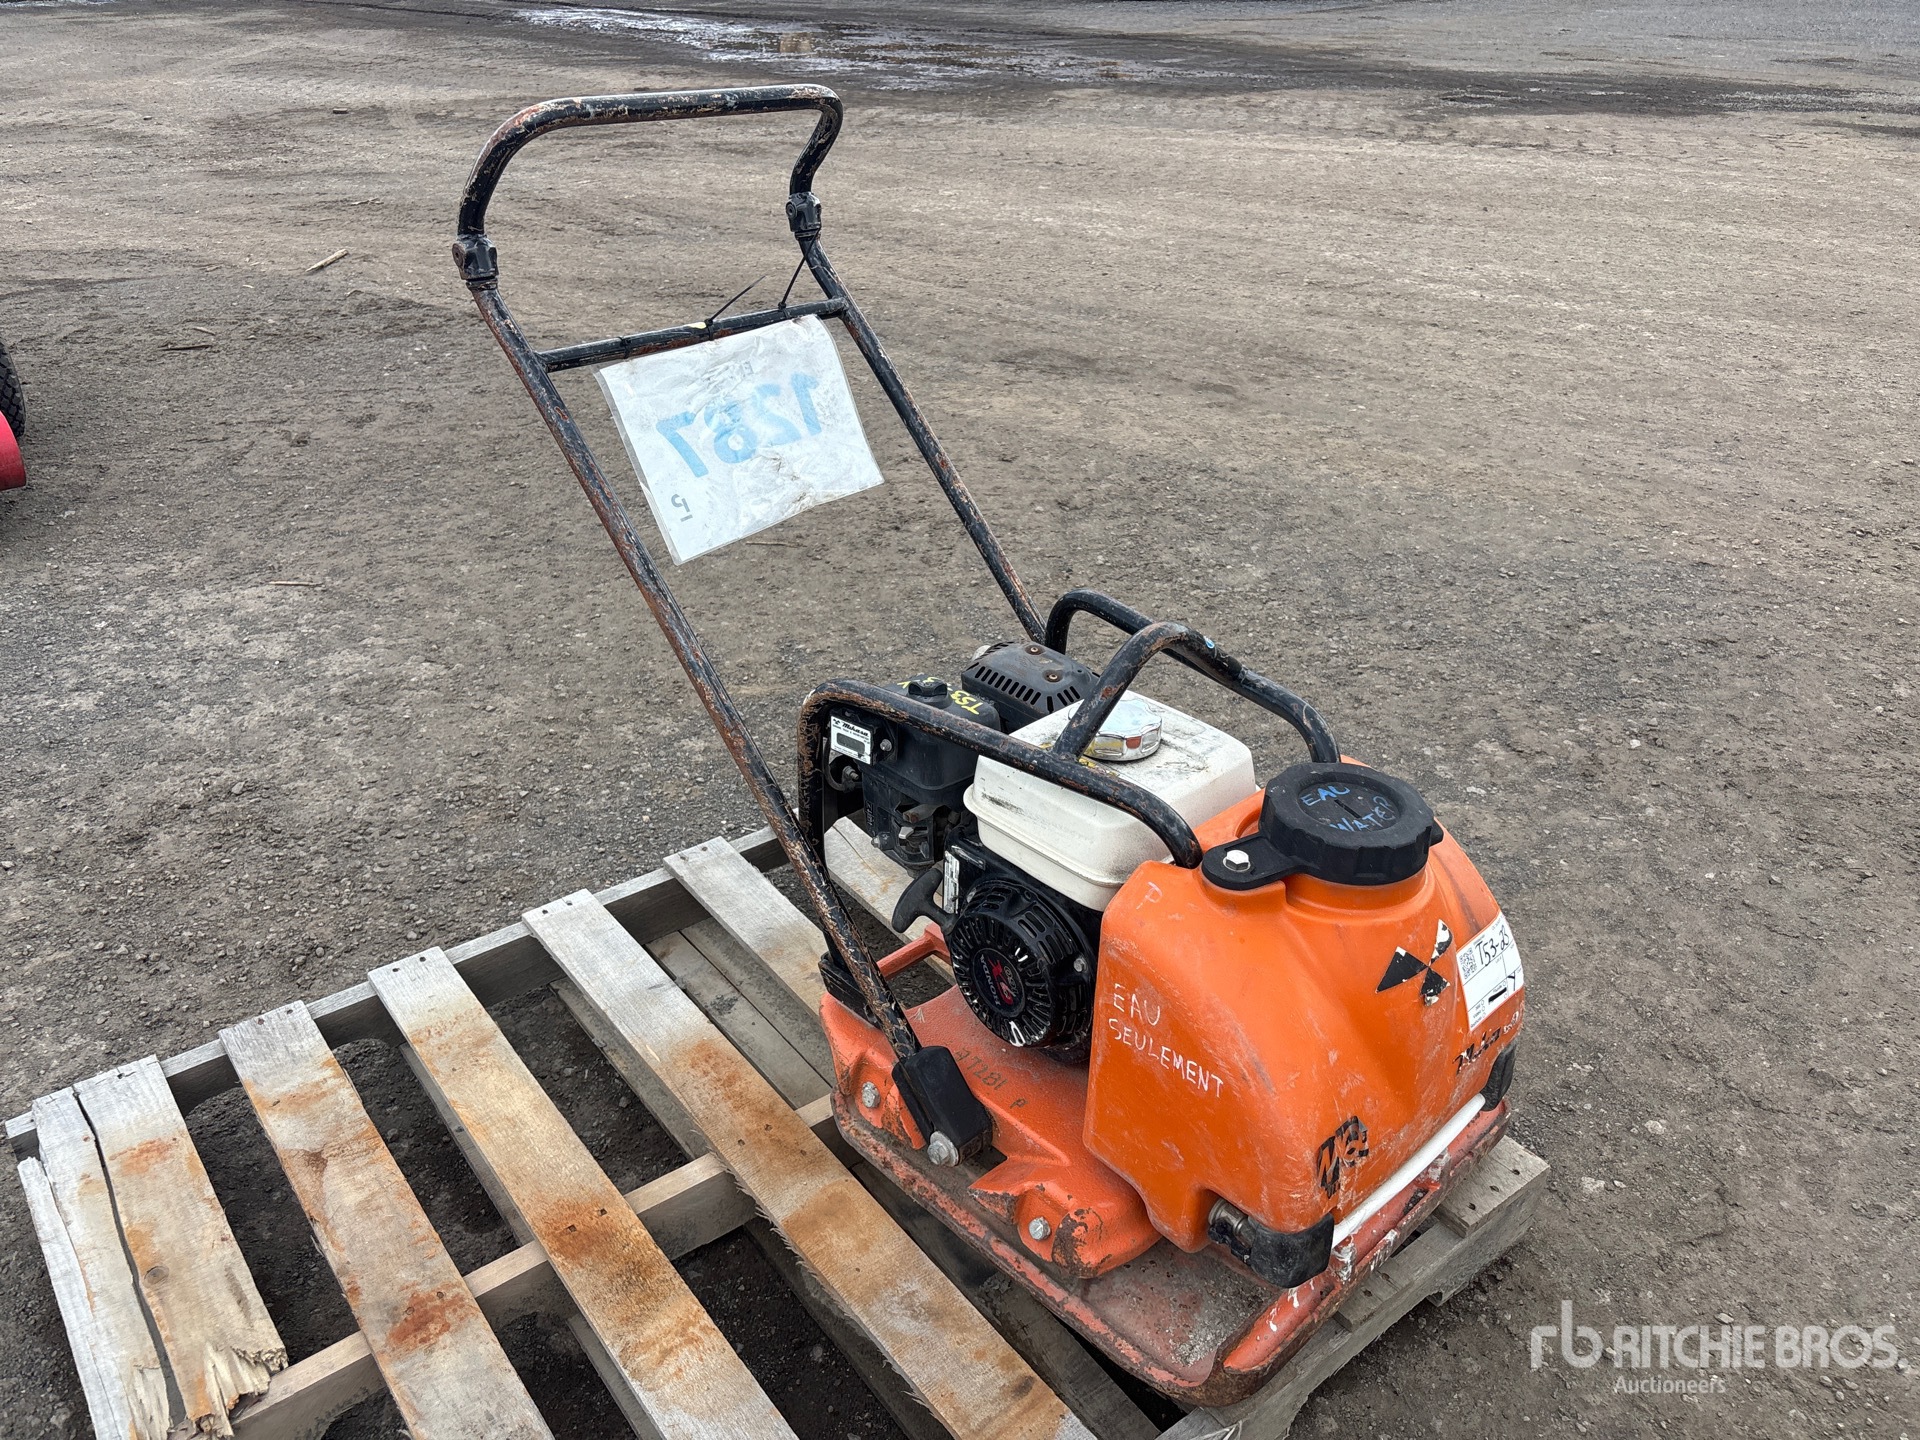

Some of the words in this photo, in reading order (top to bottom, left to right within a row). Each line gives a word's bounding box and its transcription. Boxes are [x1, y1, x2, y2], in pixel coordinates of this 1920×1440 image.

[1301, 786, 1351, 806] EAU
[1329, 796, 1397, 832] WATER
[980, 954, 1001, 1005] HONDA
[1114, 983, 1160, 1025] EAU
[1109, 1018, 1223, 1098] SEULEMENT
